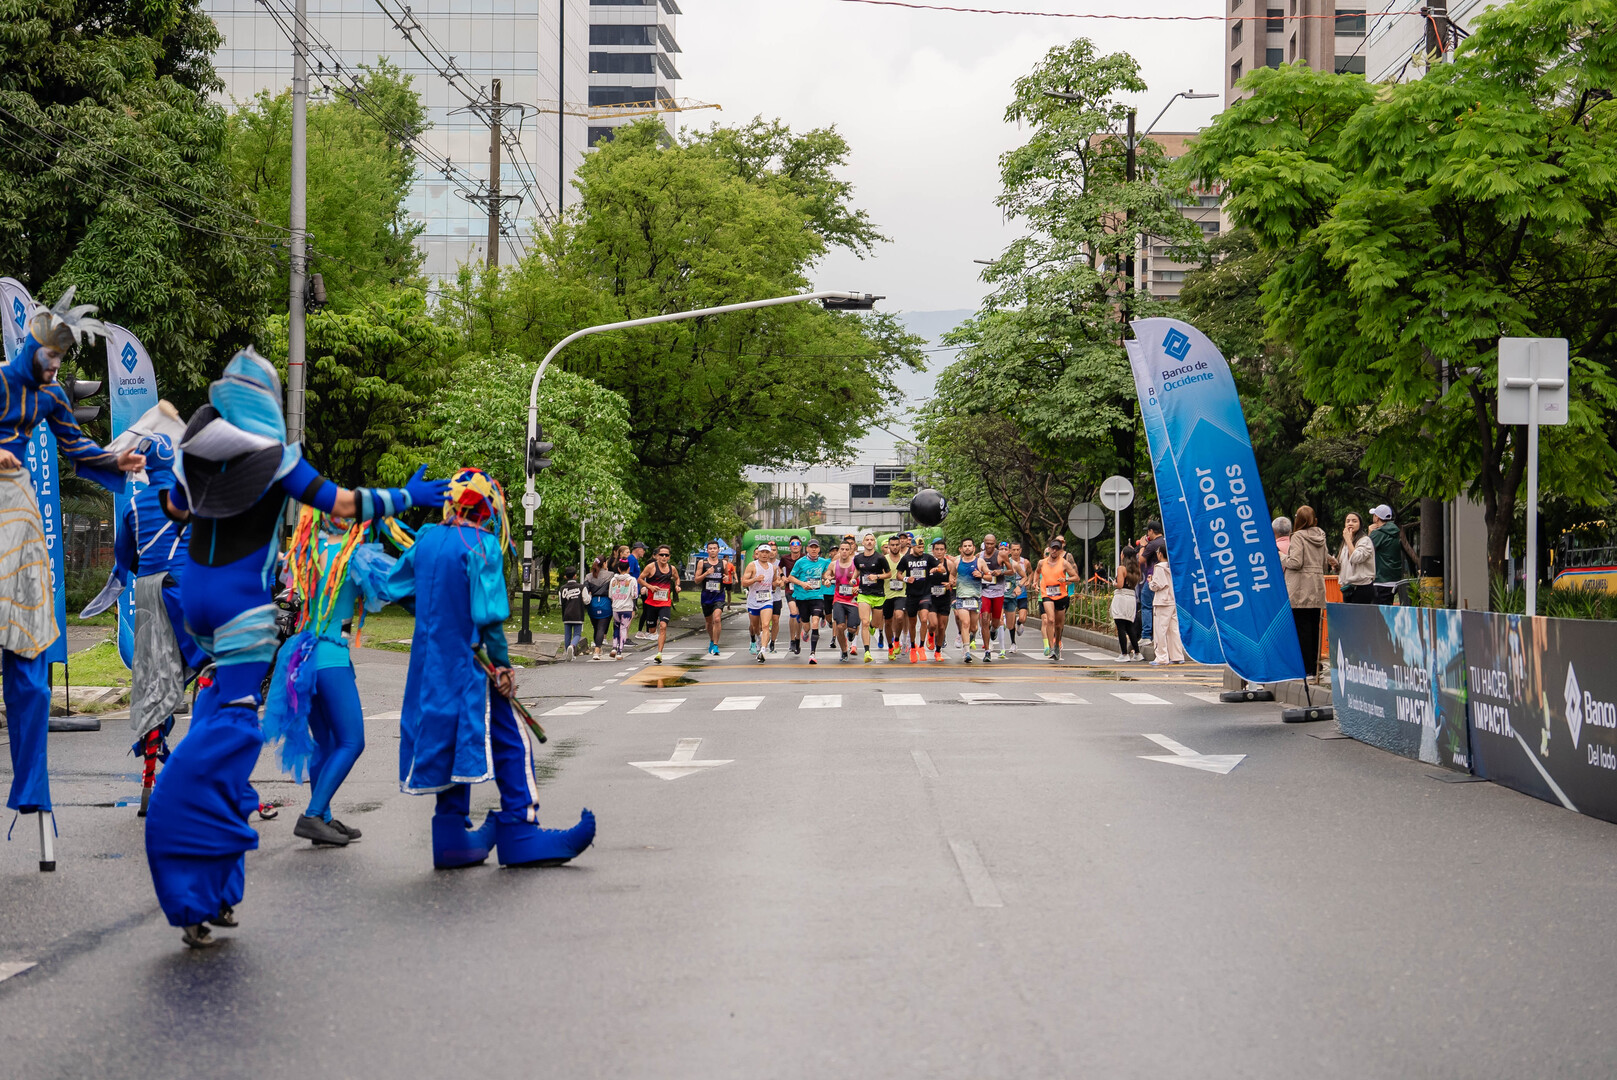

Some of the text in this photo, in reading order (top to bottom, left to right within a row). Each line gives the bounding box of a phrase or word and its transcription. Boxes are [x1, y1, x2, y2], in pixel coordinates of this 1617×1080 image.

[137, 376, 145, 385] de
[1162, 360, 1208, 381] Banco de
[1163, 372, 1215, 392] Occidente
[28, 441, 38, 473] de
[44, 504, 57, 549] que
[1195, 467, 1245, 611] Unidos por
[1225, 463, 1271, 592] tus metas
[908, 560, 928, 568] PACER
[1345, 657, 1359, 683] Banco
[1363, 661, 1388, 690] Occidente
[1393, 664, 1403, 689] TU
[1470, 666, 1511, 705] TU HACER,
[1473, 701, 1514, 738] IMPACTA.
[1583, 690, 1617, 729] Banco
[1587, 743, 1616, 770] Del lado
